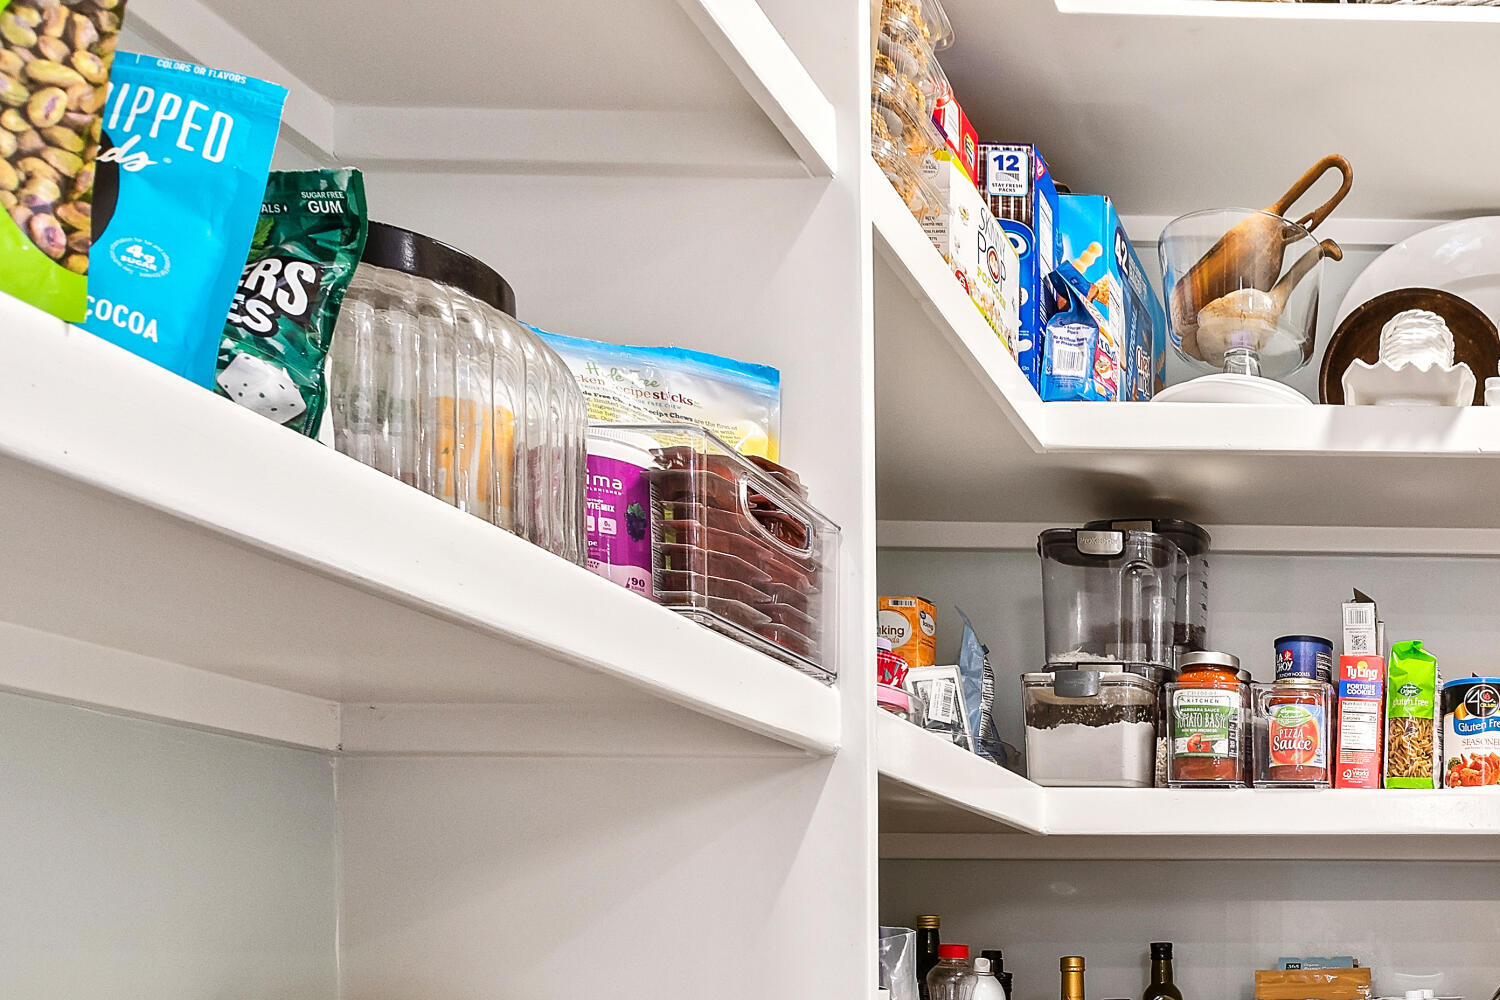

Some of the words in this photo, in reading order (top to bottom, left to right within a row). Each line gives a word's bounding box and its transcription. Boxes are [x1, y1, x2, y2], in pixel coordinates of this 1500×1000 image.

[157, 59, 191, 72] COLORS
[194, 67, 206, 76] OR
[208, 69, 247, 84] FLAVORS
[994, 155, 1019, 172] 12
[301, 191, 325, 199] SUGAR
[327, 191, 344, 199] FREE
[307, 200, 343, 214] GUM
[1412, 697, 1429, 706] free
[1205, 714, 1227, 729] BASIL
[1458, 720, 1487, 732] Gluten
[1279, 728, 1304, 739] PIZZA
[1273, 736, 1312, 751] Sauce
